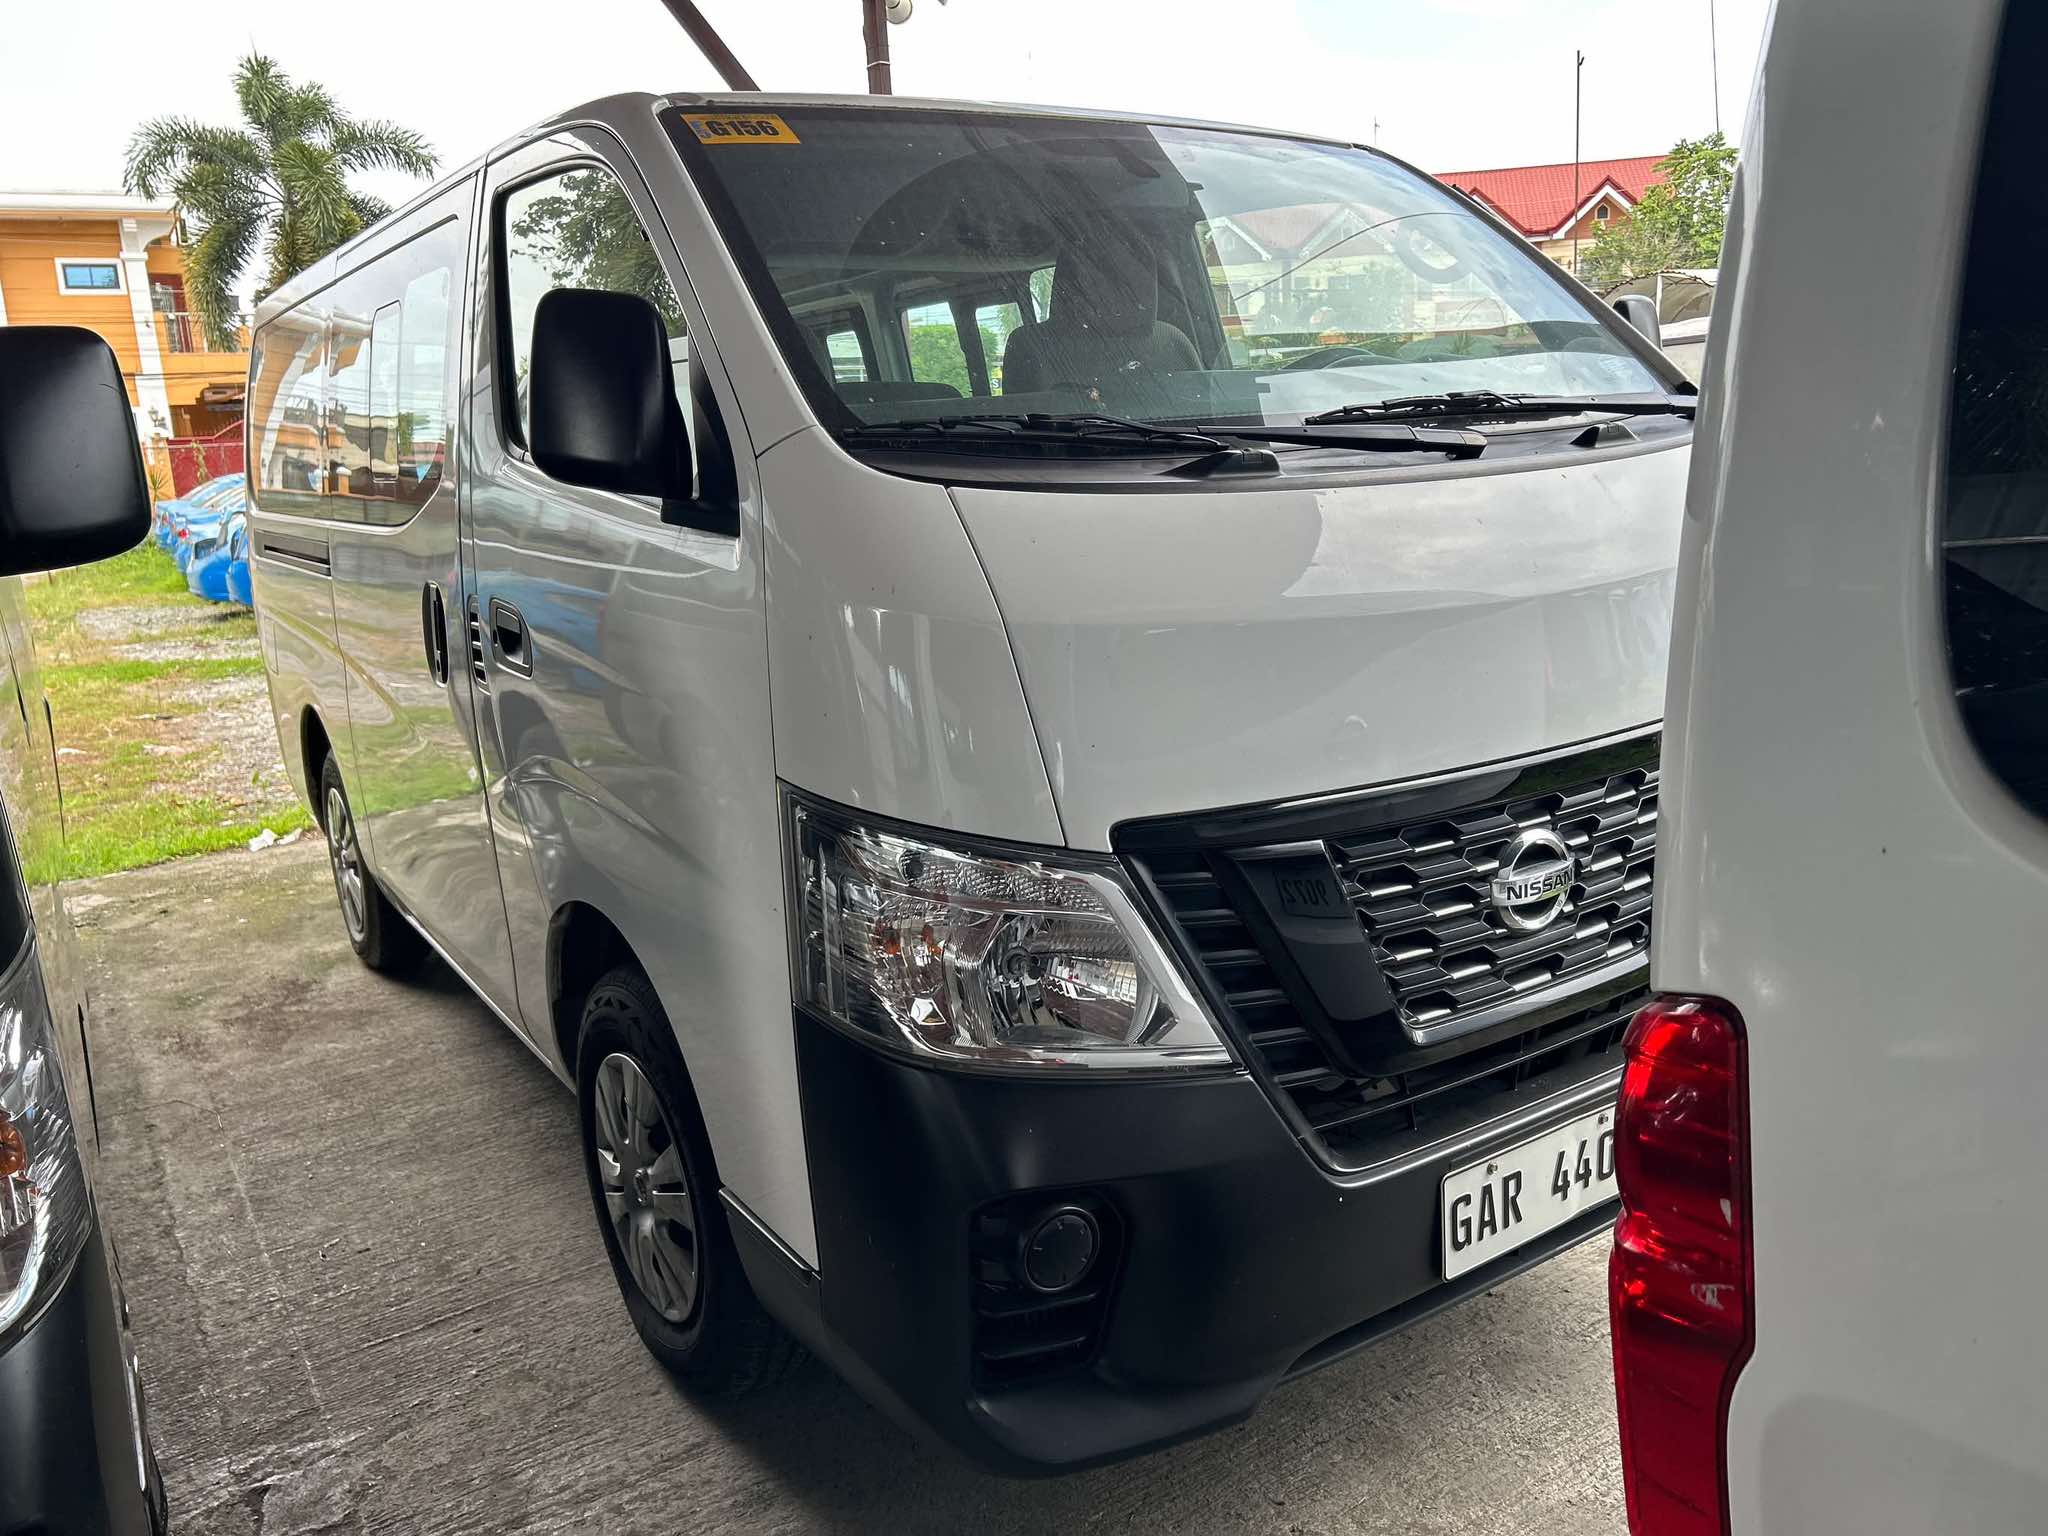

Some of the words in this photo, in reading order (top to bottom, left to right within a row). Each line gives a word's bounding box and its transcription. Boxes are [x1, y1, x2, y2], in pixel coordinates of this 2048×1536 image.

[1506, 871, 1573, 901] NISSAN
[1451, 1170, 1523, 1251] GAR
[1551, 1128, 1615, 1201] 440
